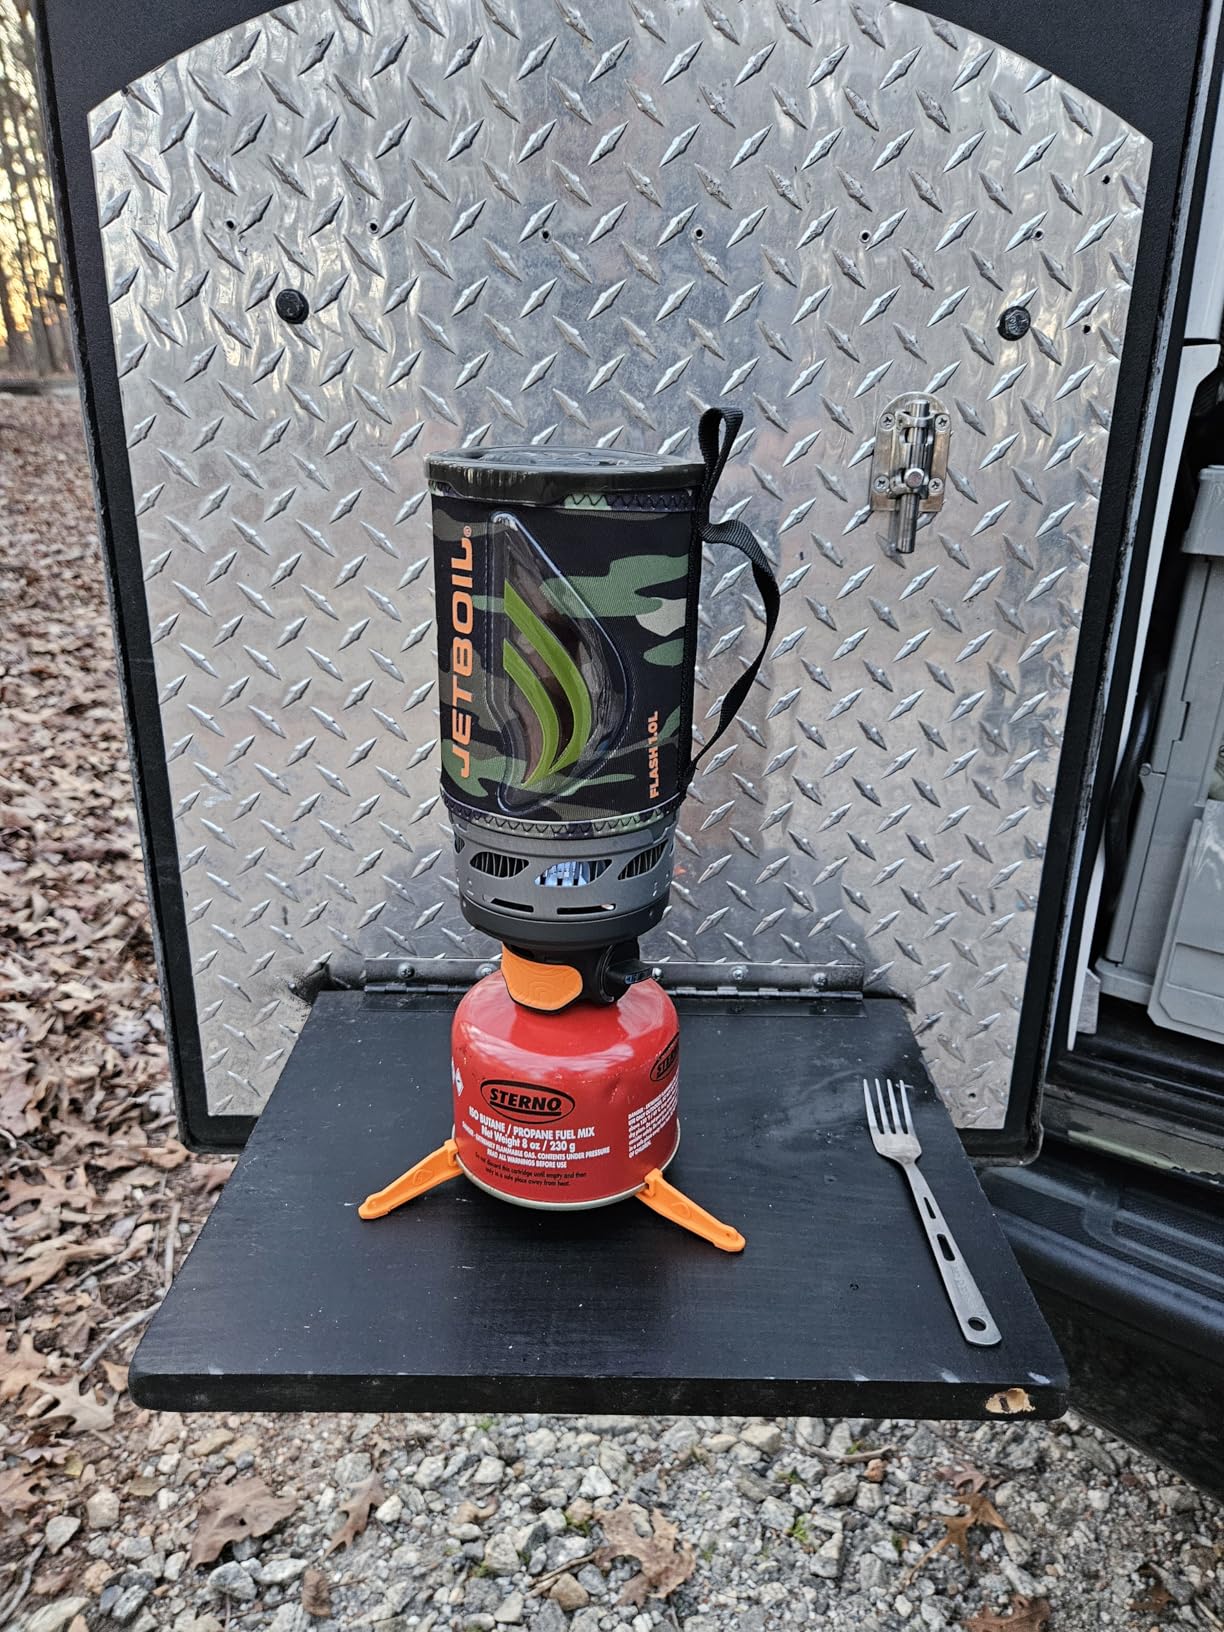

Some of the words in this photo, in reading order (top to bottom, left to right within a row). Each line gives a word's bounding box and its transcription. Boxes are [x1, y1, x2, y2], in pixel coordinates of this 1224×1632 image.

[647, 710, 659, 745] 1.0L
[648, 746, 660, 799] FLASH
[490, 1087, 562, 1112] STERNO
[469, 1105, 479, 1120] ISO
[480, 1113, 506, 1133] BUTANE
[514, 1126, 553, 1140] PROPANE
[556, 1129, 576, 1140] FUEL
[578, 1126, 595, 1139] MIX
[482, 1125, 494, 1139] Net
[495, 1131, 521, 1148] Weight
[522, 1138, 528, 1149] 8
[530, 1142, 541, 1150] oz
[550, 1140, 567, 1151] 230
[570, 1142, 576, 1153] g
[495, 1143, 523, 1158] FLAMMABLE
[538, 1152, 566, 1161] CONTENTS
[566, 1151, 585, 1161] UNDER
[586, 1146, 611, 1159] PRESSURE
[487, 1148, 499, 1159] READ
[499, 1153, 507, 1162] ALL
[508, 1154, 536, 1167] WARNINGS
[536, 1160, 556, 1168] BEFORE
[557, 1161, 567, 1169] USE
